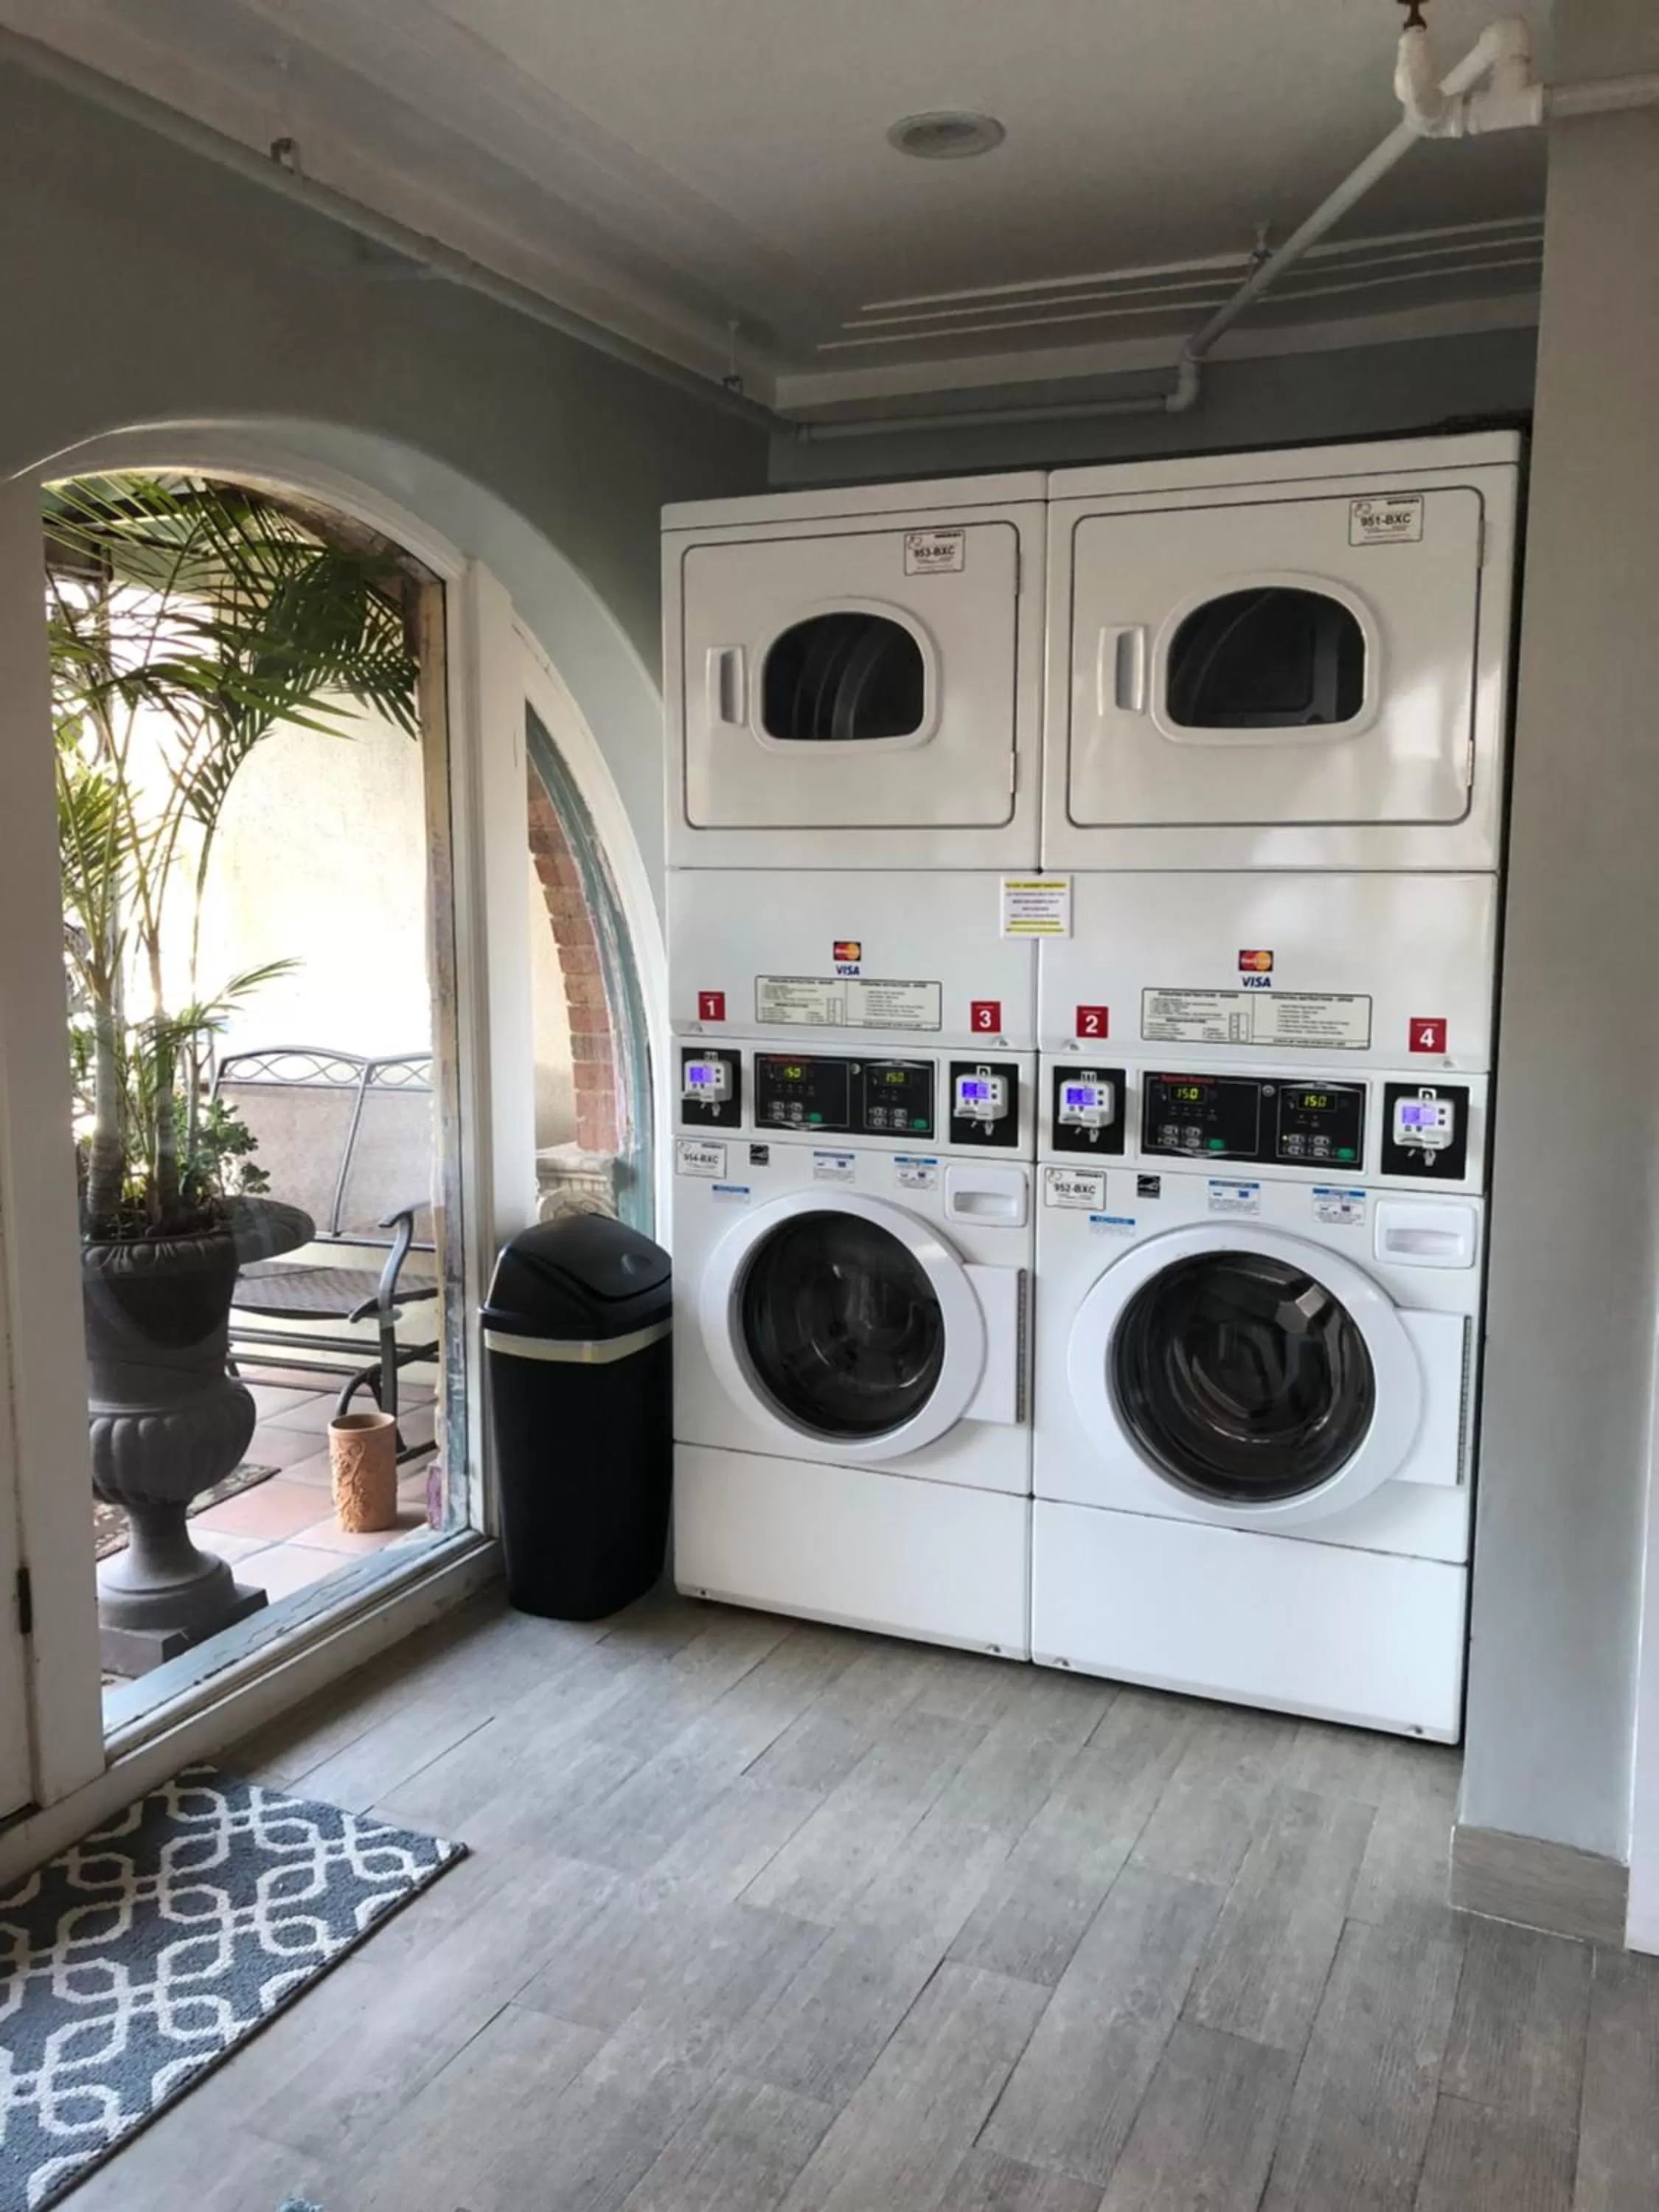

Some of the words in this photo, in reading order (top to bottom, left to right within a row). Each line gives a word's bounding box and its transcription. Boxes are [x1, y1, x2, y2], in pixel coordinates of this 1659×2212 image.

[1360, 512, 1411, 526] 951-BXC
[836, 964, 860, 975] VISA
[1242, 975, 1271, 987] VISA
[707, 999, 716, 1017] 1
[978, 1009, 992, 1029] 3
[1085, 1015, 1099, 1034] 2
[1419, 1028, 1436, 1048] 4
[1177, 1087, 1199, 1100] 150
[1304, 1094, 1327, 1107] 150
[1053, 1181, 1097, 1194] 952-BXC
